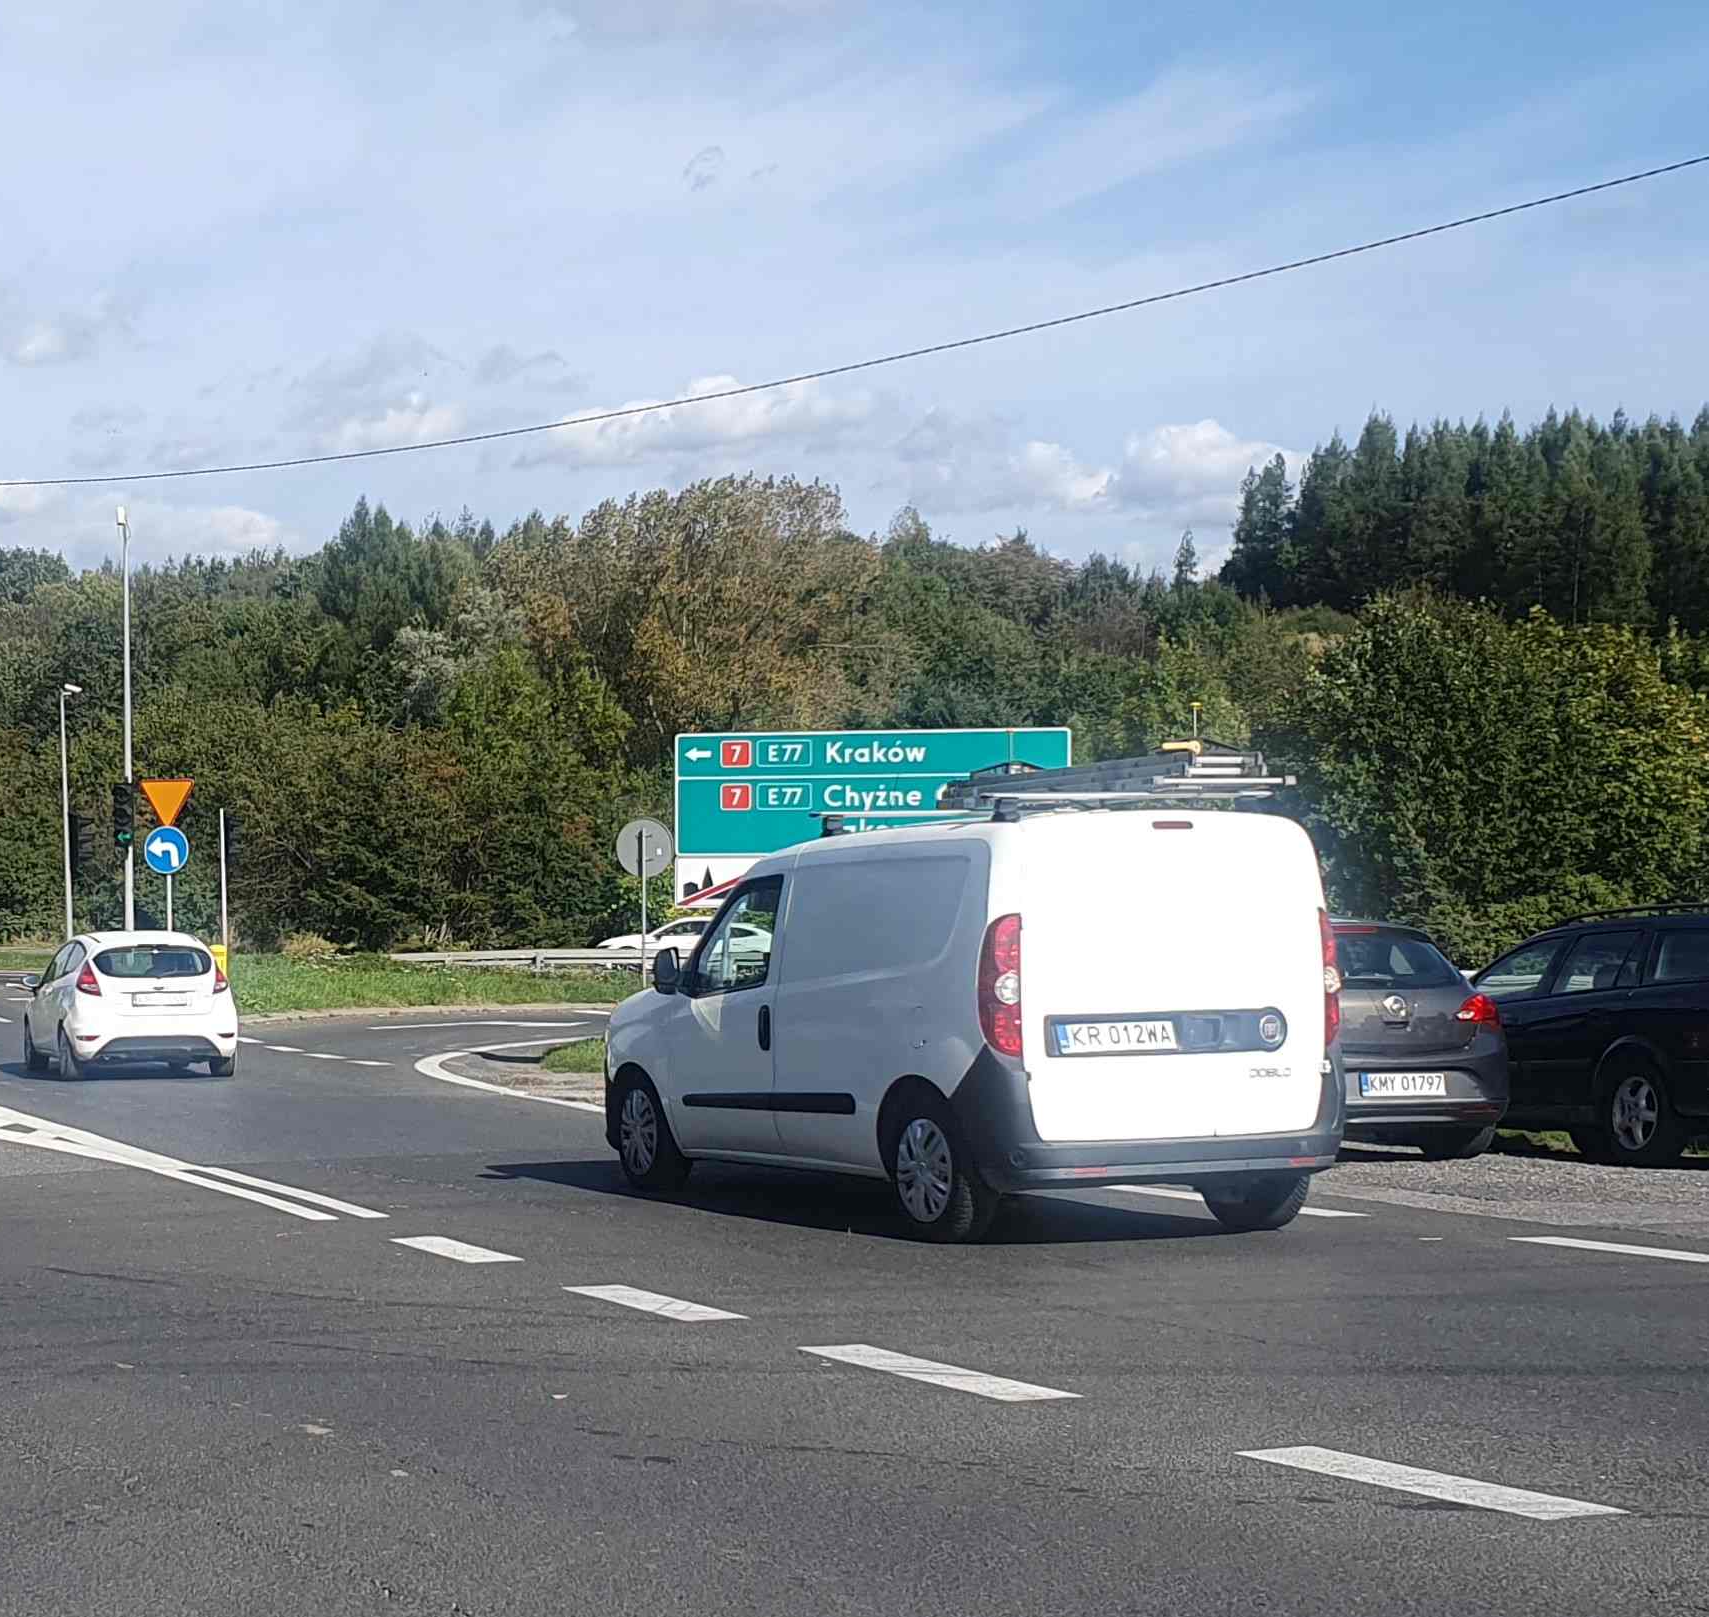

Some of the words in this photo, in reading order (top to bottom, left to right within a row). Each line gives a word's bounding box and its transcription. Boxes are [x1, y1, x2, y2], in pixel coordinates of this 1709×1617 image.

[729, 745, 743, 764] 7
[825, 740, 927, 764] Kraków
[729, 788, 743, 807] 7
[823, 784, 923, 811] Chyżne
[1071, 1025, 1103, 1046] KR
[1109, 1023, 1172, 1045] 012WA
[1370, 1075, 1396, 1091] KMY
[1401, 1075, 1443, 1091] 01797
